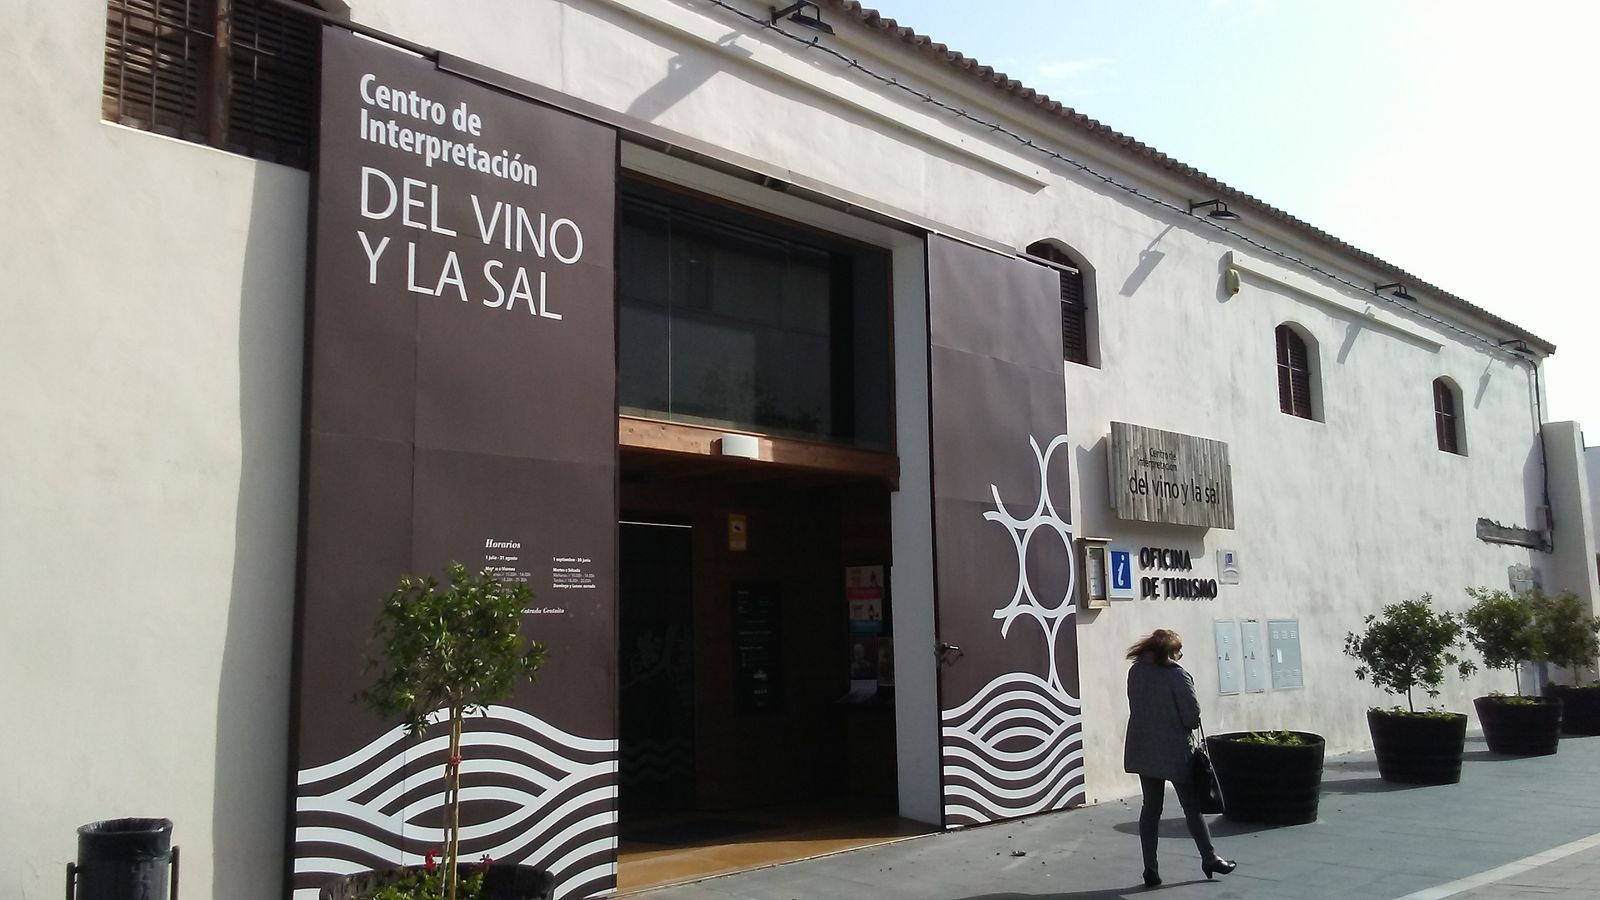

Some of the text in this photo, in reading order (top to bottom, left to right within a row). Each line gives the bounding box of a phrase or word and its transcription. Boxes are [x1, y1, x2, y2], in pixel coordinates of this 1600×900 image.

[360, 73, 482, 136] Centro de
[360, 108, 538, 187] Interpretación
[361, 166, 584, 264] DEL VINO
[357, 230, 563, 320] Y LA SAL
[1149, 447, 1177, 461] Centro de
[1129, 469, 1220, 506] del vino y la sal
[485, 538, 521, 549] Horarios
[1140, 546, 1193, 571] OFICINA
[1140, 576, 1218, 599] DE TURISMO
